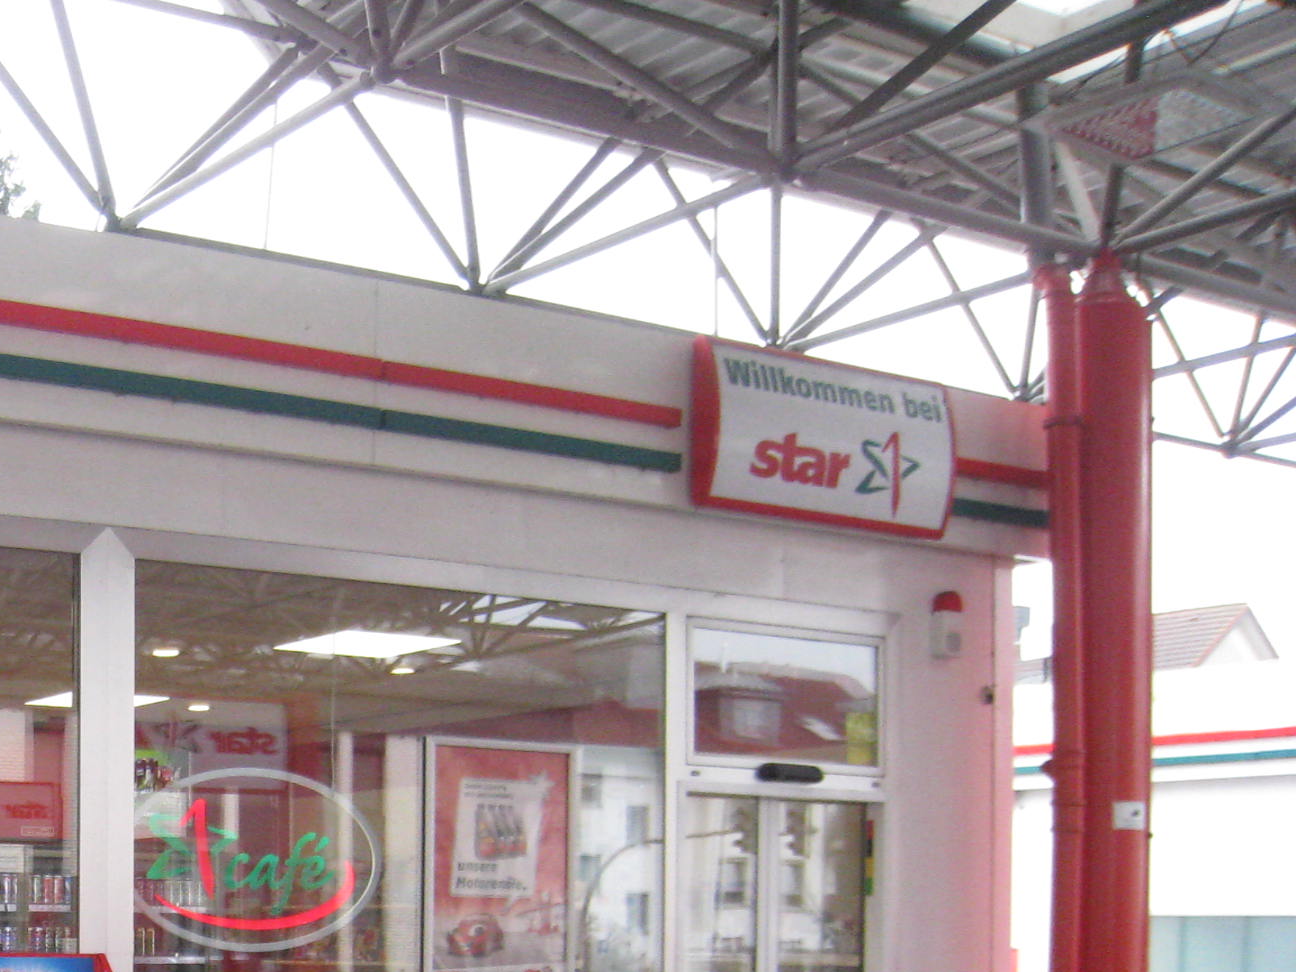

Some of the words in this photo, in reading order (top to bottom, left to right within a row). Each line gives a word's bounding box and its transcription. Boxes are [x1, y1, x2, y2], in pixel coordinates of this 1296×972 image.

[724, 357, 895, 415] Willkommen
[902, 393, 942, 423] bei
[749, 433, 852, 489] star
[224, 832, 337, 915] café
